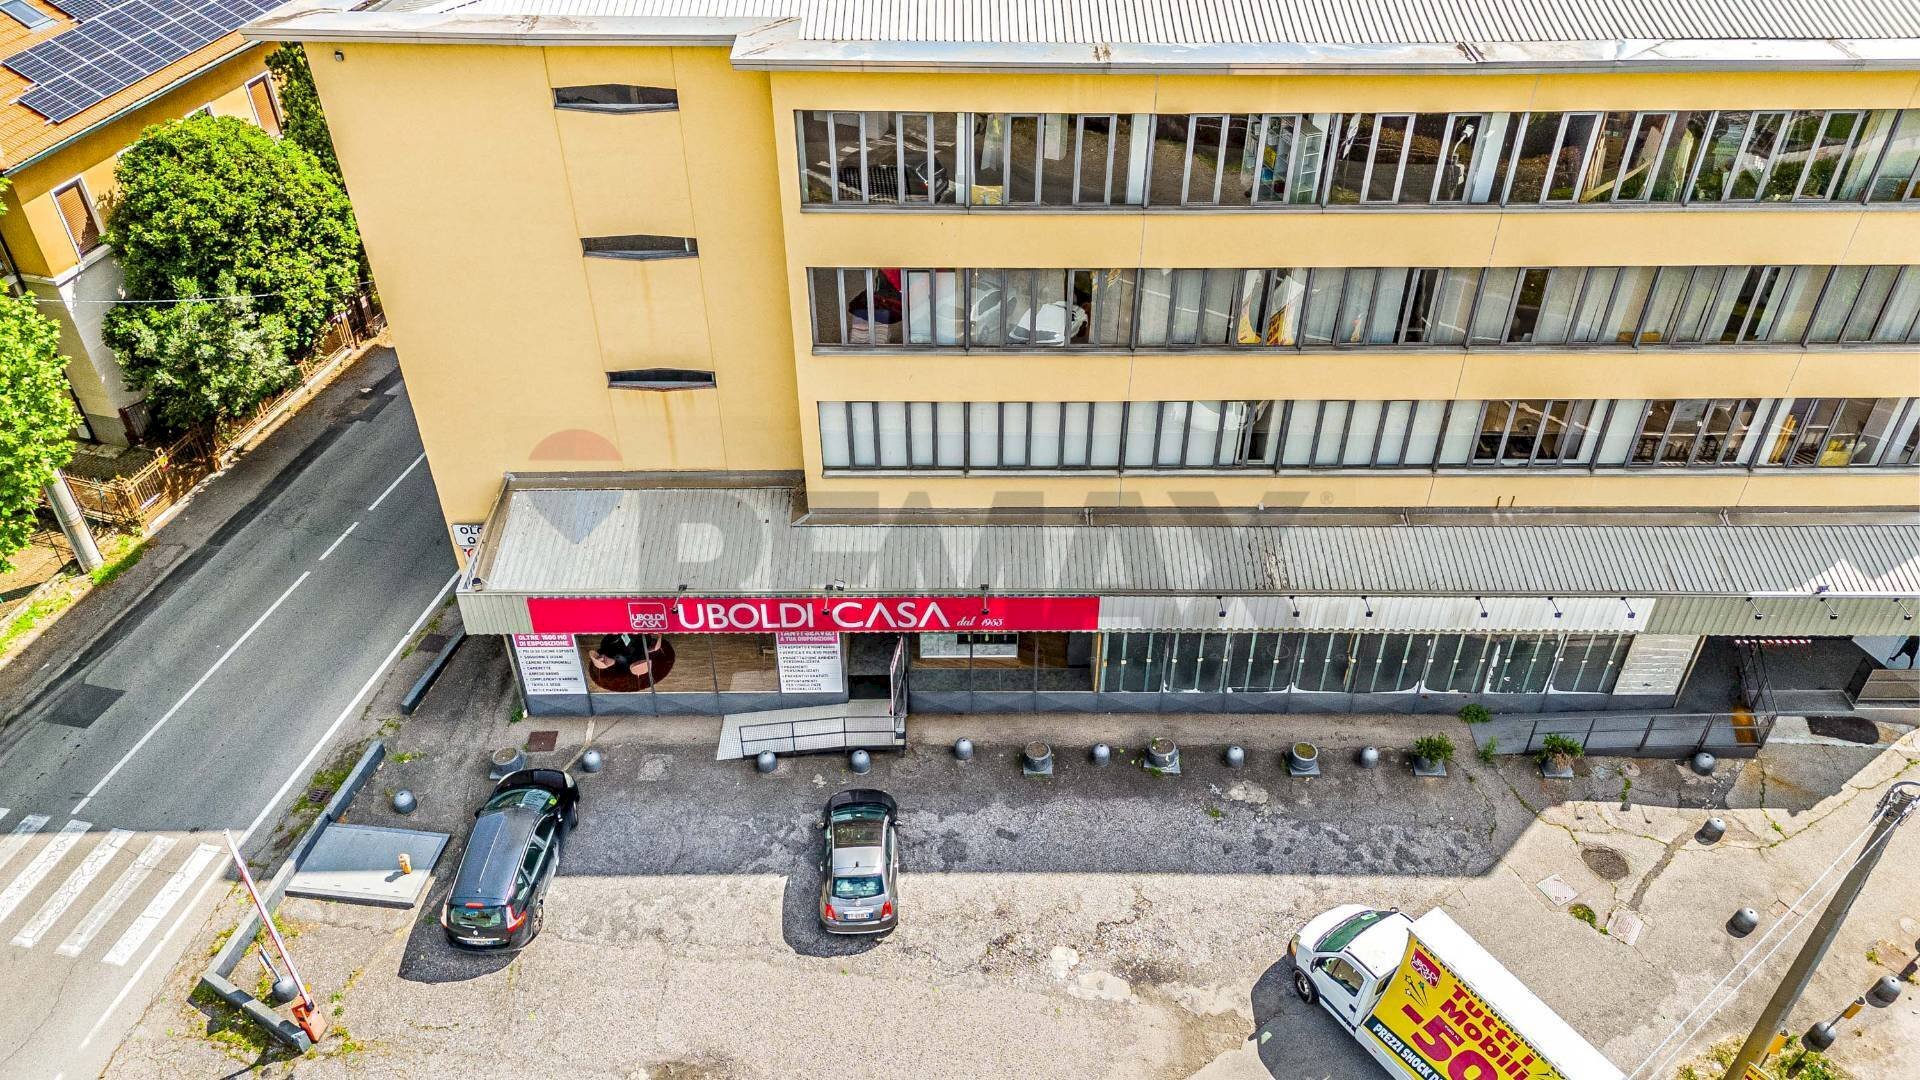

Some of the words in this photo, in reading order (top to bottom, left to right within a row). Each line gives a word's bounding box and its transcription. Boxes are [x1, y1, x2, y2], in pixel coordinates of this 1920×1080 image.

[631, 614, 665, 622] UBOLDI
[678, 603, 814, 629] UBOLDI
[832, 602, 950, 629] CASA
[957, 616, 977, 627] dal
[981, 617, 1004, 627] 1953
[1373, 1023, 1404, 1054] PREZZI
[1400, 1048, 1432, 1078] SHOCK
[1440, 998, 1530, 1080] Mobili
[1452, 983, 1521, 1053] Tutti
[1521, 1053, 1536, 1066] i
